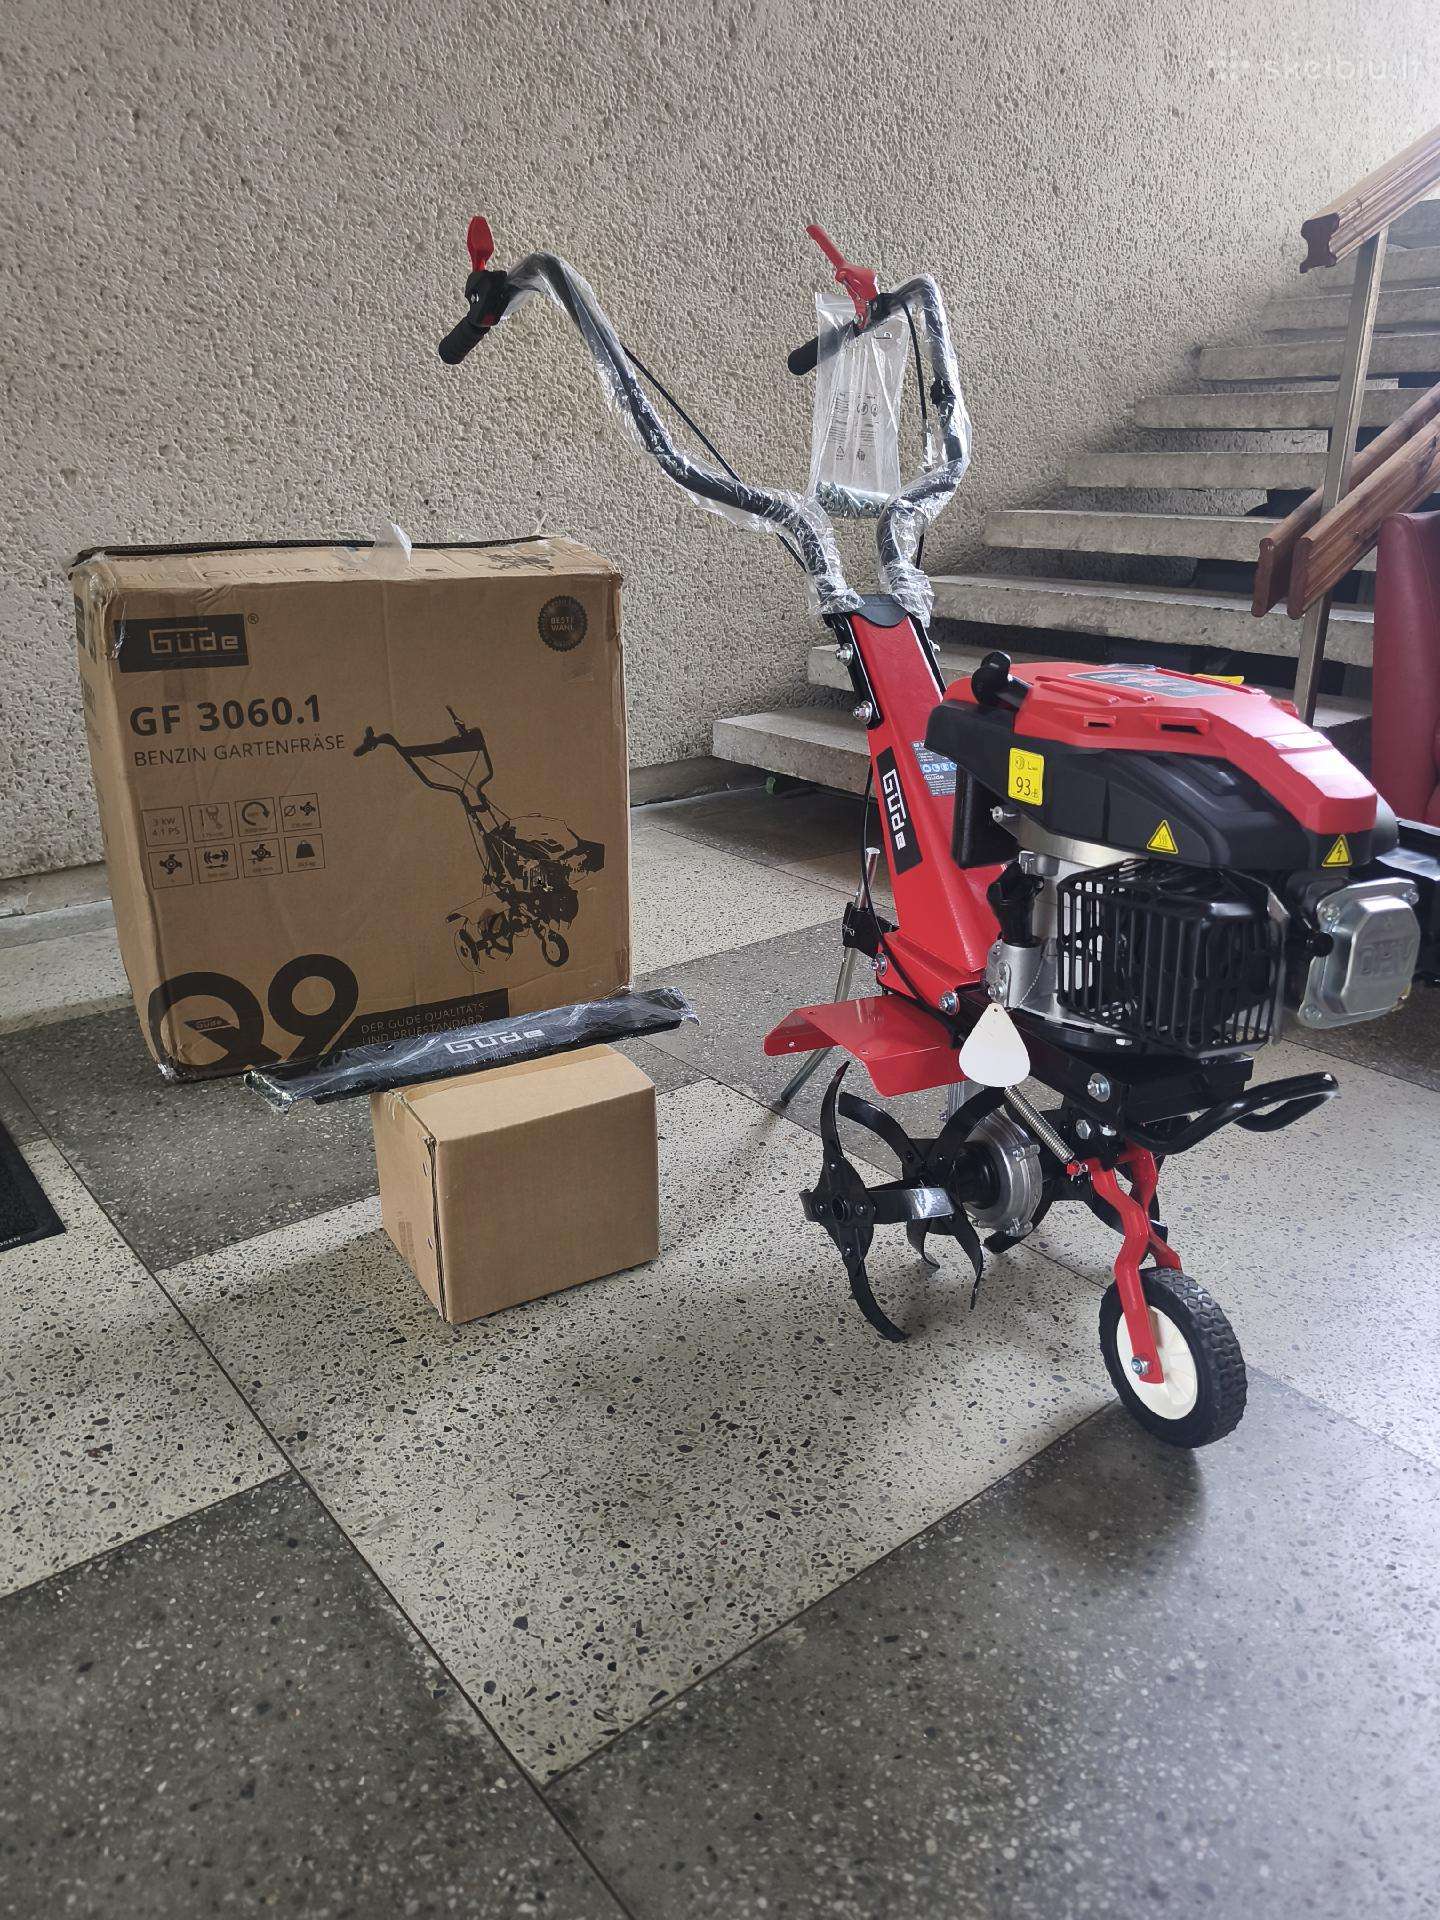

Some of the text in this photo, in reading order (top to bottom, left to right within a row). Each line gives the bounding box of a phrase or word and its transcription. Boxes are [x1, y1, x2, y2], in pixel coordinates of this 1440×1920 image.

[129, 694, 321, 736] GF 3060.1
[134, 733, 346, 767] BENZIN GARTENFRÄSE
[1016, 776, 1031, 796] 93
[148, 953, 359, 1083] Q9
[361, 1020, 385, 1034] DER
